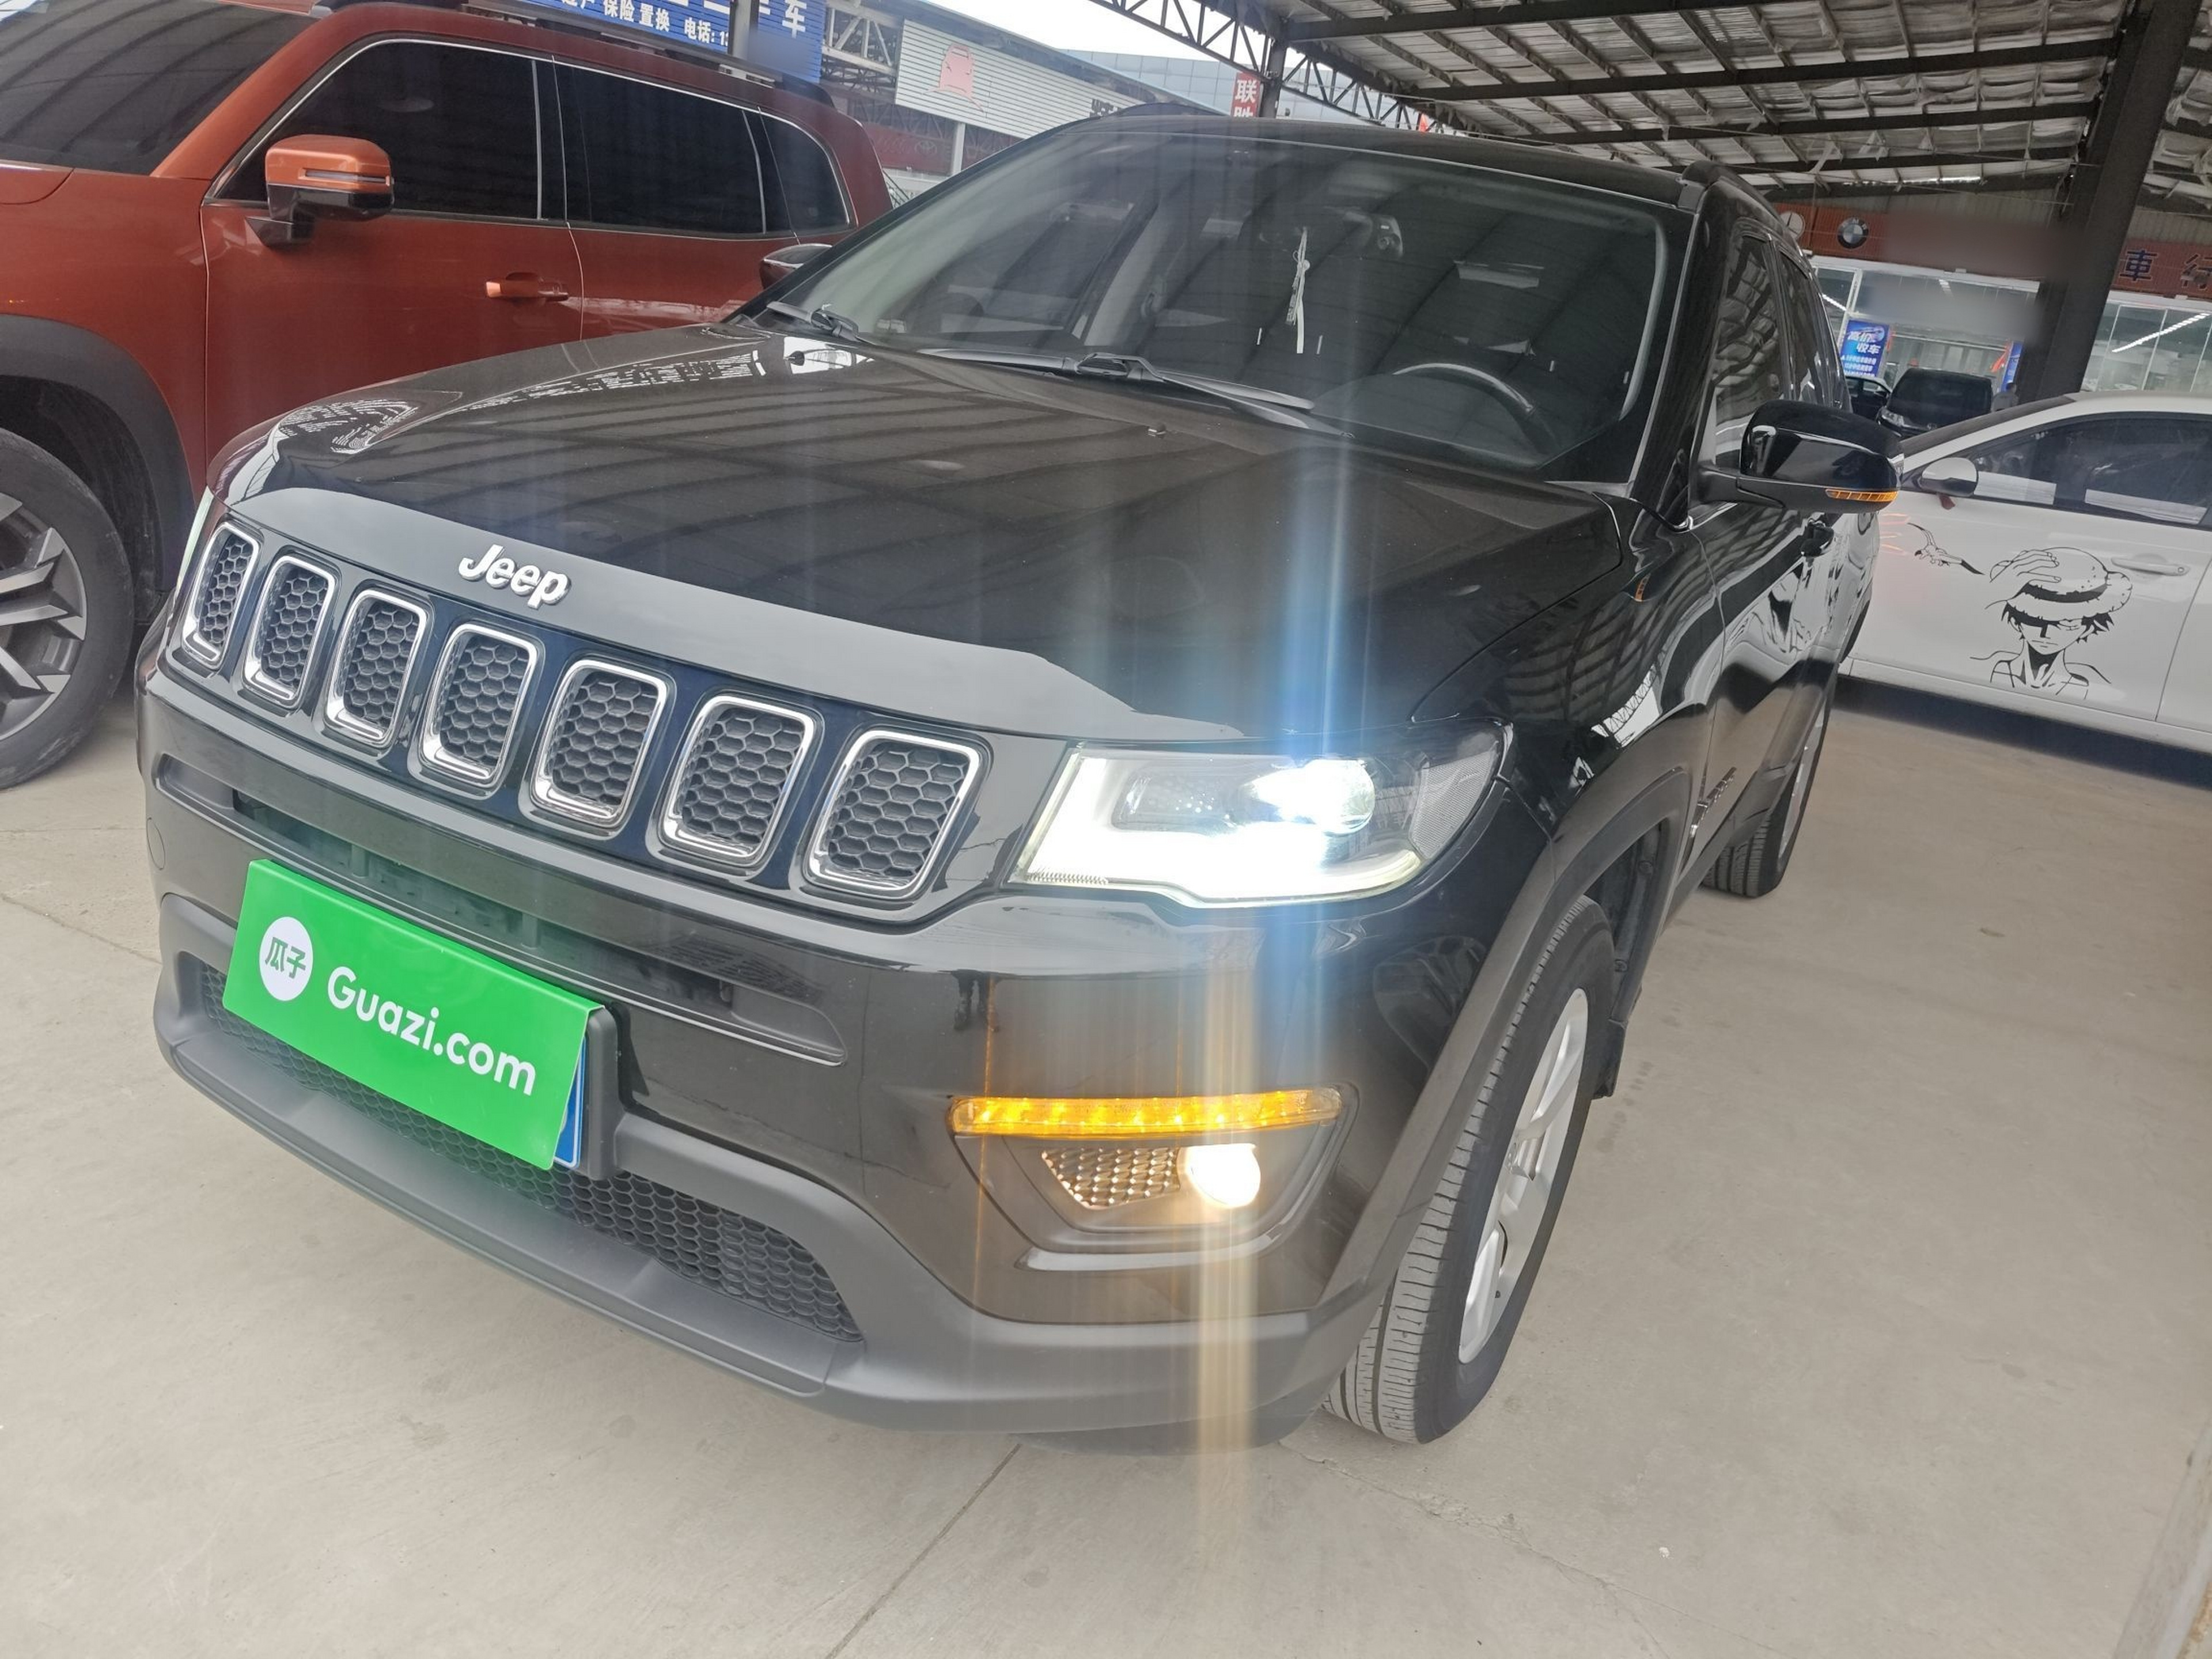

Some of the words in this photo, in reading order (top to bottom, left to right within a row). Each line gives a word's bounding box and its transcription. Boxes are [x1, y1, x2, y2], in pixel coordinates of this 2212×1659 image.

[639, 3, 669, 32] 置换
[458, 544, 571, 610] Jeep
[264, 937, 306, 979] 瓜子
[328, 966, 536, 1096] Guazi.com
